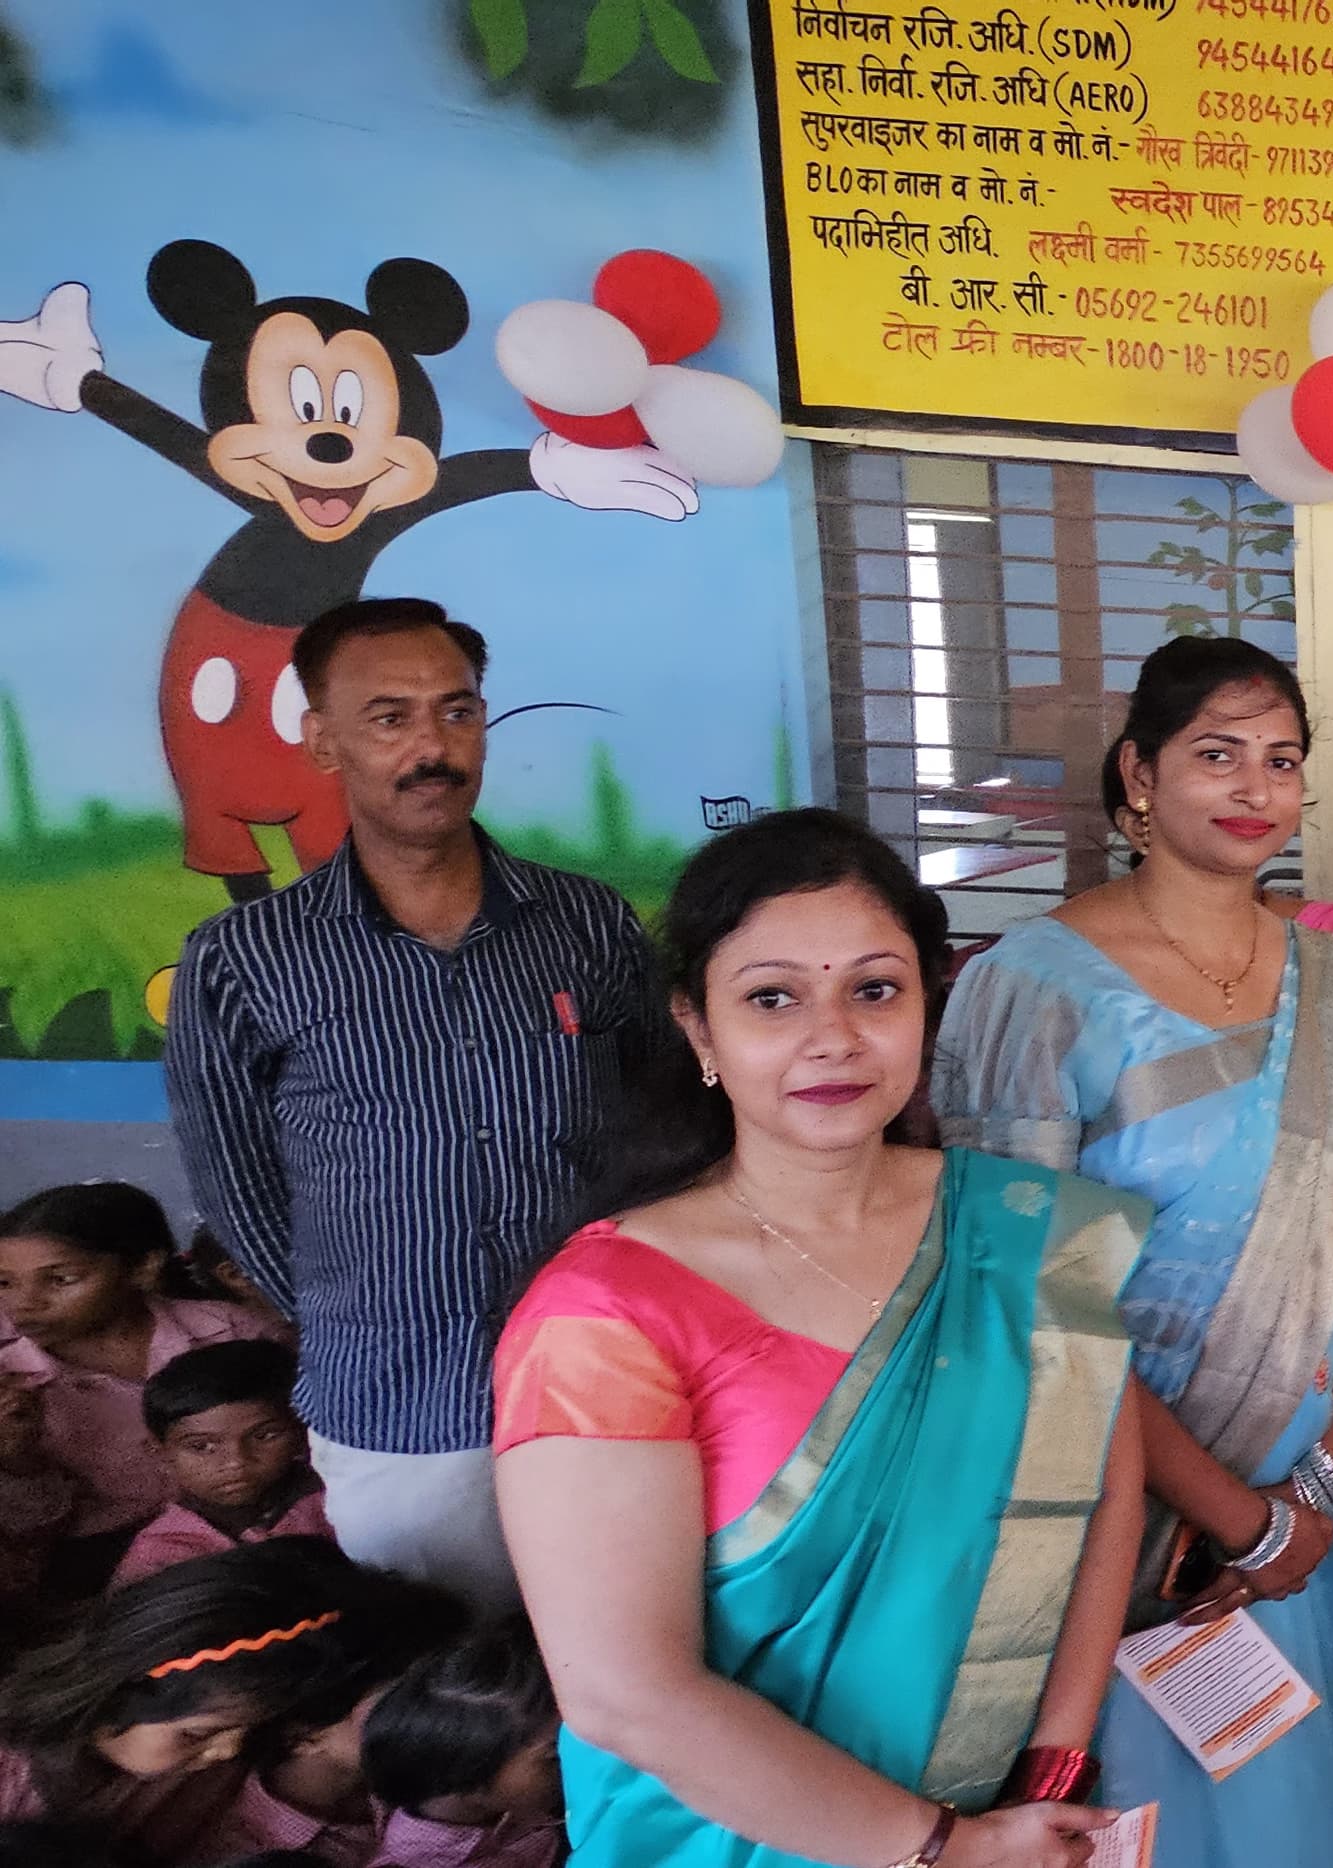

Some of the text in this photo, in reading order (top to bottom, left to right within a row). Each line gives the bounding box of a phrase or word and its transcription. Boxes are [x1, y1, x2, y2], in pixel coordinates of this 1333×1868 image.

[903, 6, 963, 50] रजि.
[1038, 15, 1131, 71] (SDM)
[931, 60, 986, 106] रजि.
[1053, 71, 1148, 125] (AERO)
[936, 122, 967, 151] का
[973, 125, 1023, 155] नाम
[1028, 129, 1047, 155] व
[1053, 121, 1089, 160] मो.
[806, 162, 852, 193] BLO
[856, 168, 888, 195] का
[894, 171, 942, 199] नाम
[950, 175, 969, 200] व
[979, 167, 1014, 205] मो.
[1108, 180, 1197, 224] स्वदेश
[938, 214, 999, 258] अधि.
[1175, 240, 1326, 277] 7355699564
[900, 265, 940, 309] बी.
[951, 278, 1006, 314] आर.
[882, 312, 940, 361] टोल
